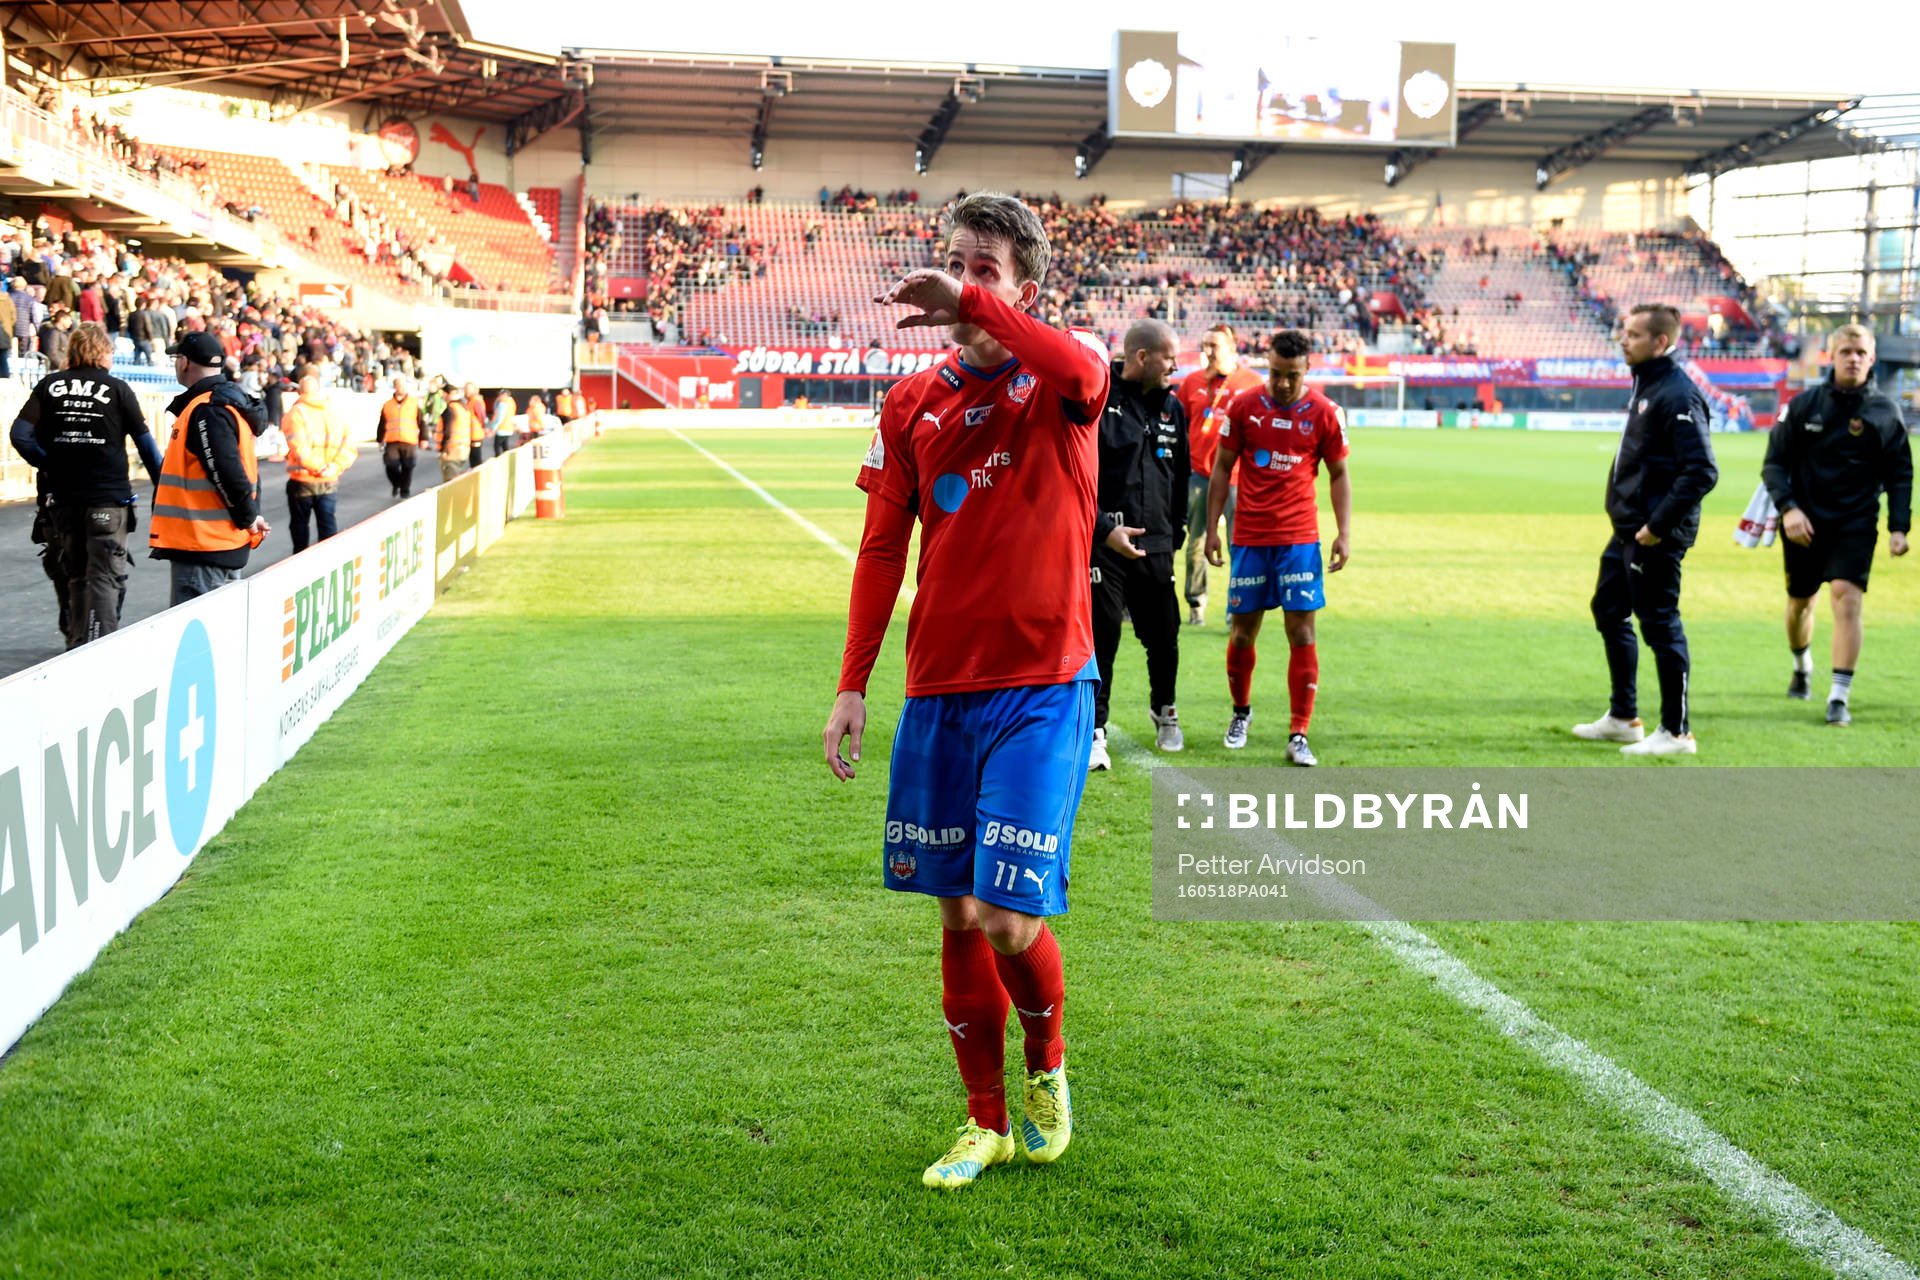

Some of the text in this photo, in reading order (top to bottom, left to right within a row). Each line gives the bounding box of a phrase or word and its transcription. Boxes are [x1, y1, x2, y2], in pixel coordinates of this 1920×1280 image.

[733, 346, 813, 374] SÖDRA
[817, 348, 860, 374] STÅ
[48, 379, 111, 404] GML
[63, 400, 94, 408] SPORT
[1237, 576, 1267, 587] SOLID
[1282, 572, 1314, 583] SOLID
[292, 560, 354, 676] PEAB
[905, 823, 965, 845] SOLID
[1000, 825, 1058, 853] SOLID
[994, 860, 1018, 891] 11
